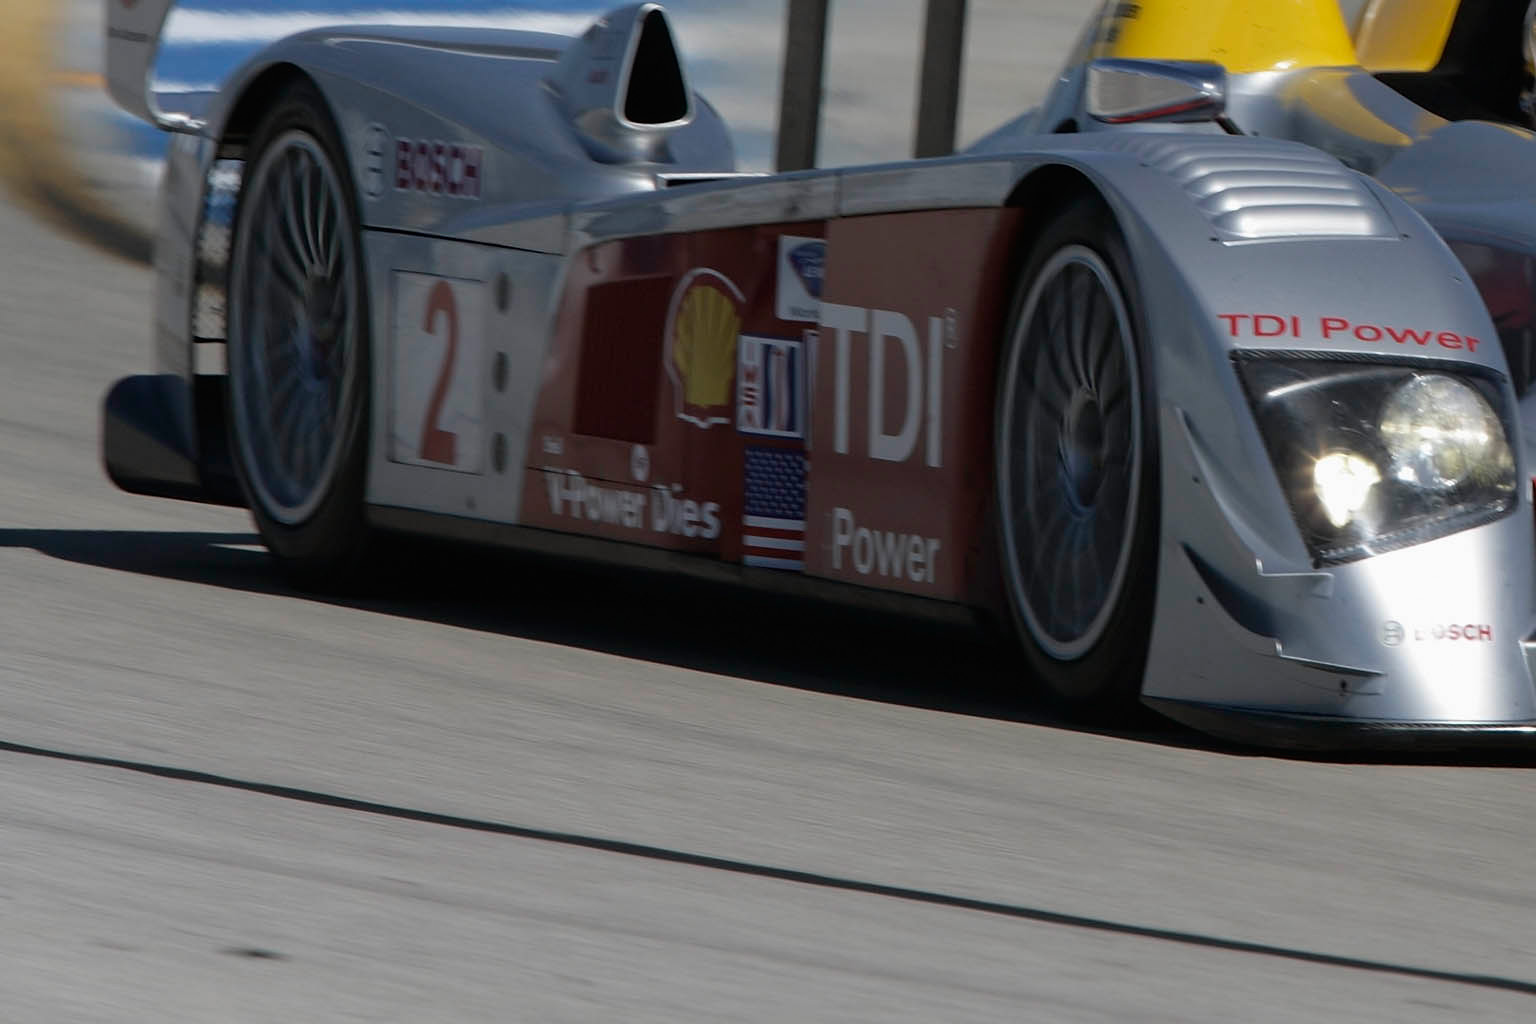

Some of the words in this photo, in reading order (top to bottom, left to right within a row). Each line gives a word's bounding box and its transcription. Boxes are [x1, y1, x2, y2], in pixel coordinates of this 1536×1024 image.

[395, 139, 482, 198] BOSCH
[1217, 313, 1300, 337] TDI
[1319, 317, 1480, 353] Power
[420, 280, 459, 466] 2
[817, 301, 945, 468] TDI
[832, 506, 941, 584] Power
